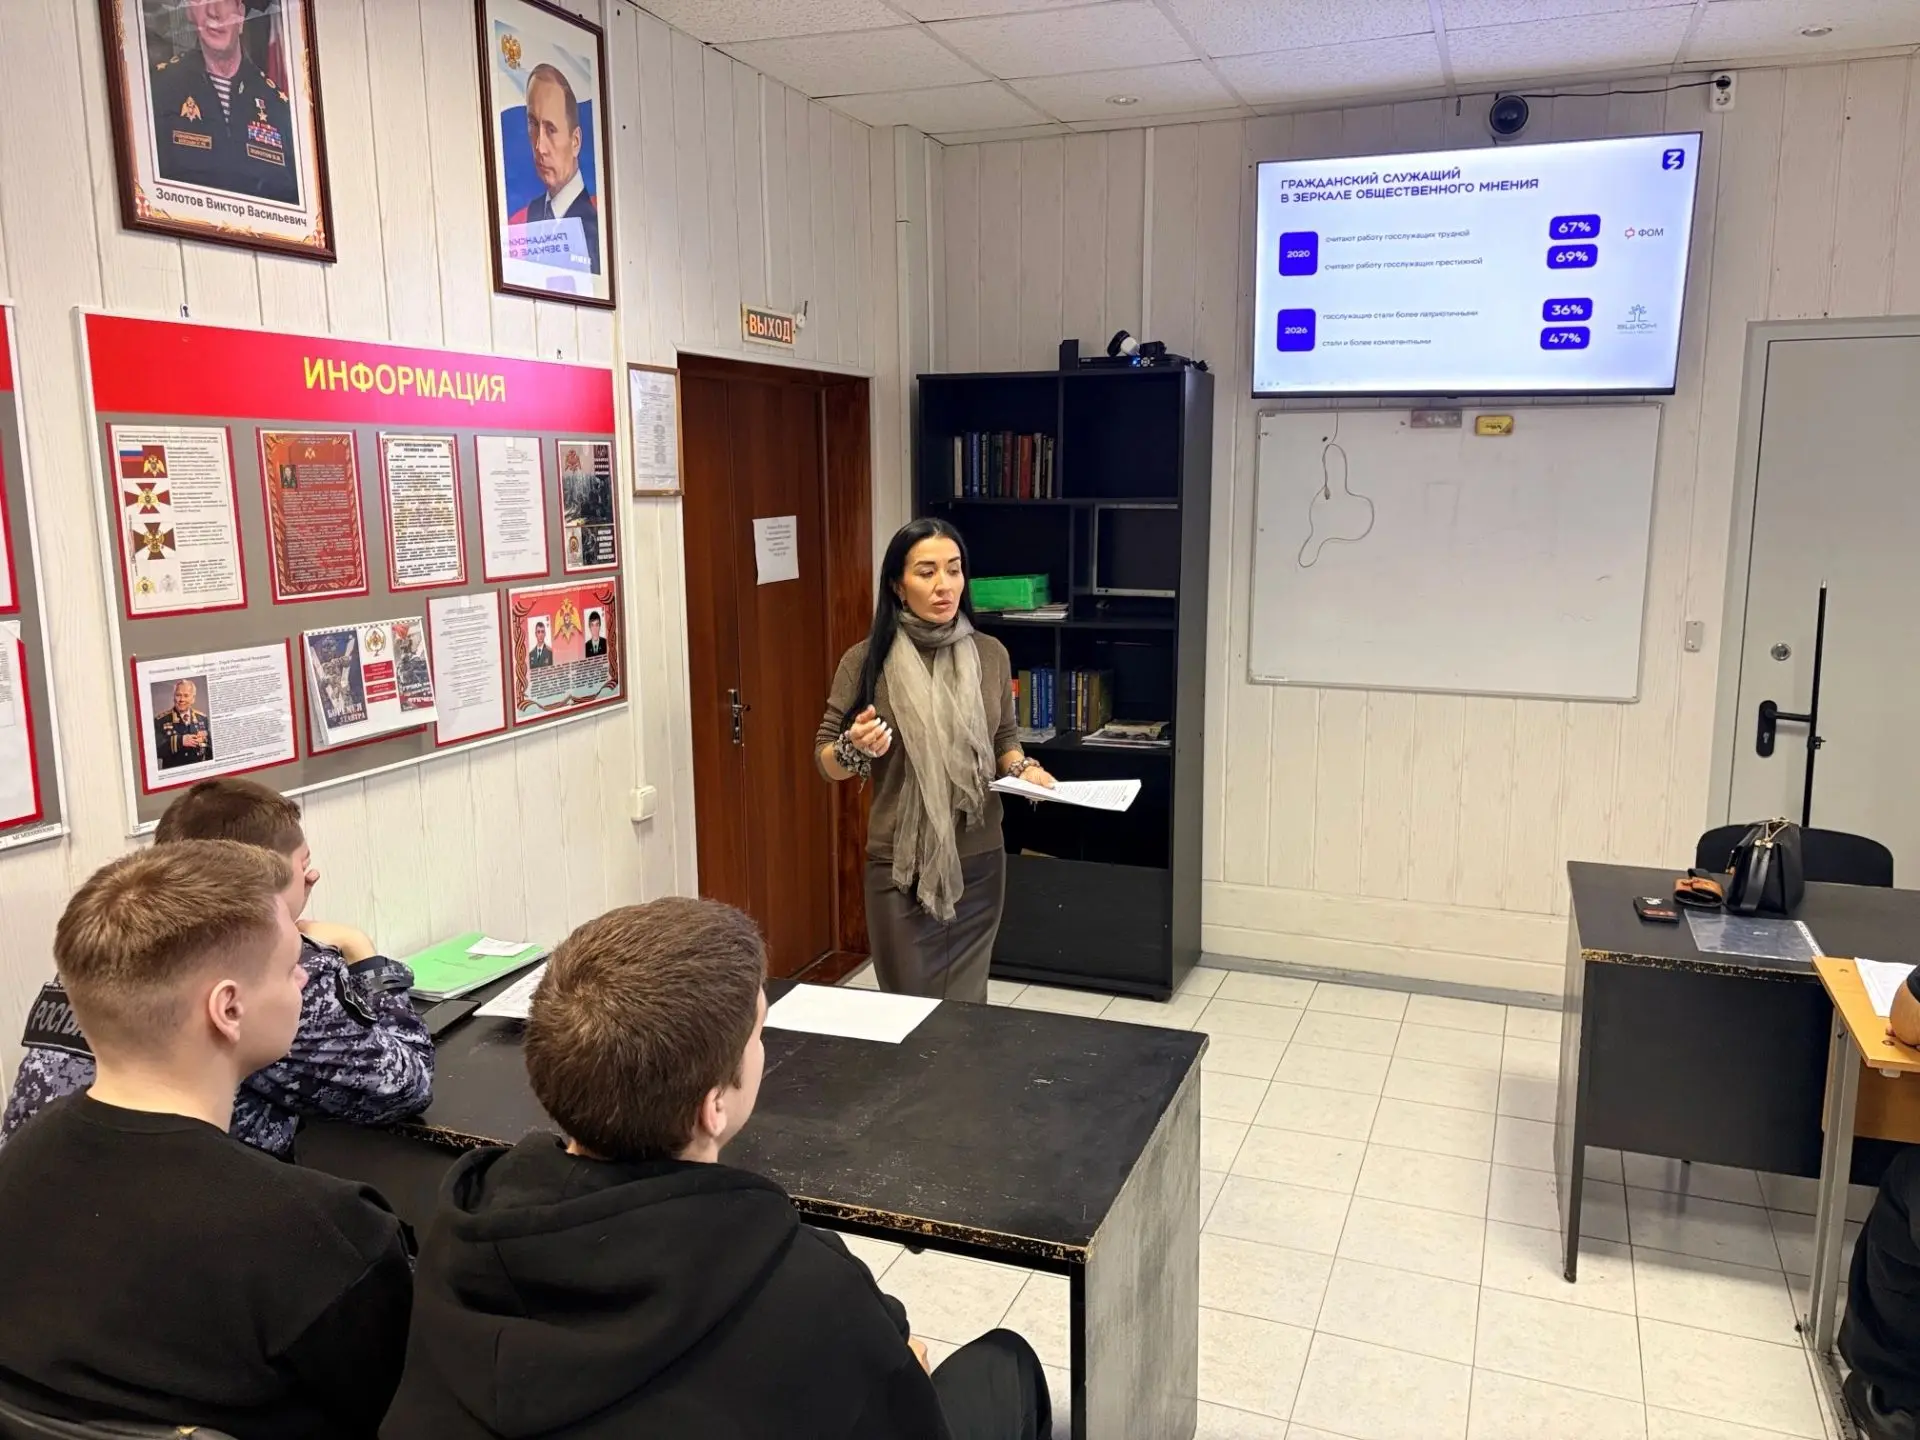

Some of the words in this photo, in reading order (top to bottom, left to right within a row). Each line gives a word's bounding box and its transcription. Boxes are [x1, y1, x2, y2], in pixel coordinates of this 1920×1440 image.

[1280, 171, 1379, 190] ГРАЖДАНСКИЙ
[1382, 166, 1461, 184] СЛУЖАЩИЙ
[1280, 193, 1290, 204] В
[1293, 189, 1352, 203] ЗЕРКАЛЕ
[1355, 182, 1475, 199] ОБЩЕСТВЕННОГО
[1478, 178, 1540, 193] МНЕНИЯ
[155, 187, 204, 207] Золотов
[206, 196, 246, 217] Виктор
[248, 205, 308, 228] Васильевич
[1558, 221, 1592, 234] 67%
[1637, 228, 1664, 237] ФОМ
[1325, 235, 1356, 243] считают
[1357, 233, 1383, 242] работу
[1384, 231, 1436, 241] госслужащих
[1438, 229, 1470, 240] трудной
[1286, 249, 1311, 259] 2020
[1555, 250, 1589, 263] 69%
[1324, 263, 1355, 271] считают
[1355, 261, 1382, 271] работу
[1383, 259, 1434, 270] госслужащих
[1435, 256, 1483, 268] престижной
[1395, 310, 1419, 319] более
[1551, 304, 1584, 316] 36%
[748, 313, 791, 343] ВЫХОД
[1284, 326, 1308, 335] 2026
[1349, 338, 1372, 346] более
[1548, 332, 1582, 344] 47%
[302, 355, 507, 406] ИНФОРМАЦИЯ
